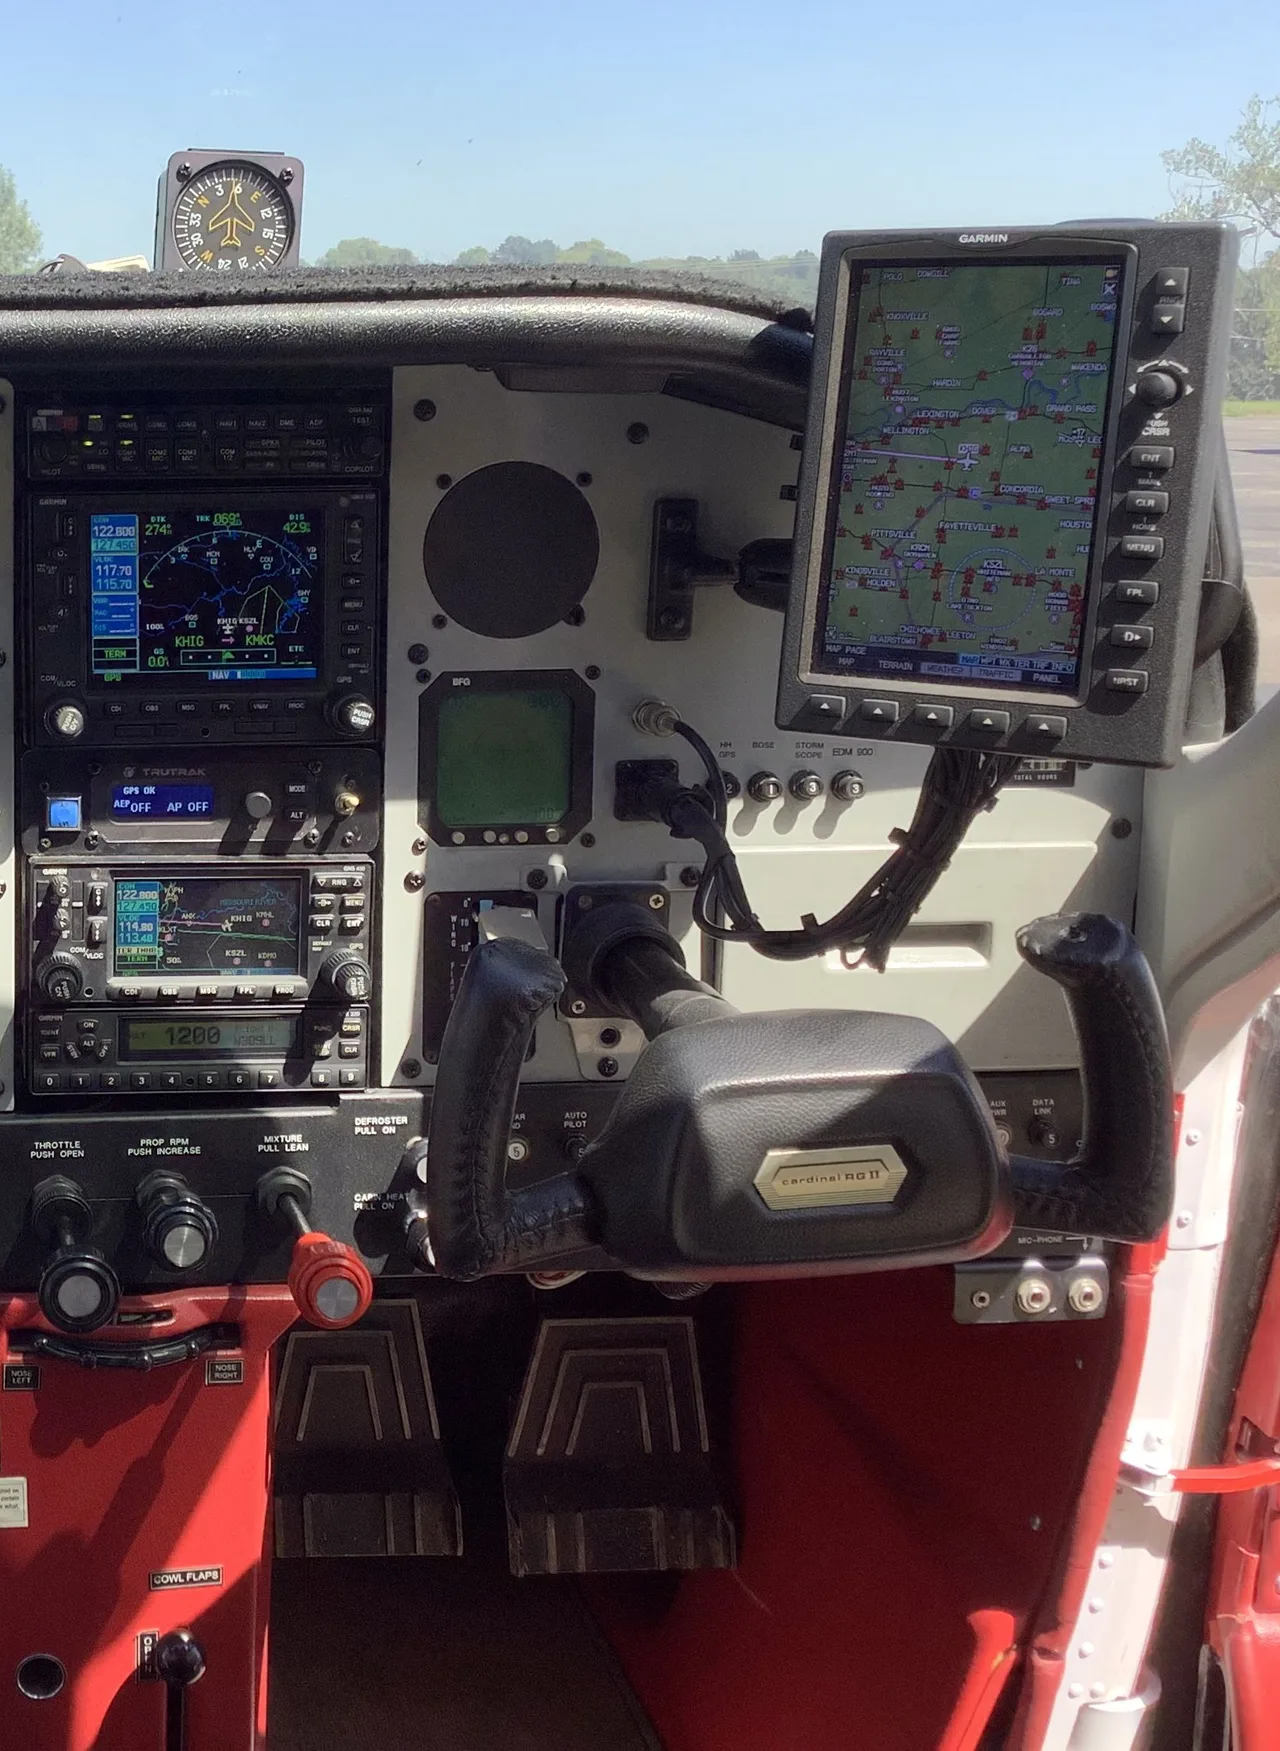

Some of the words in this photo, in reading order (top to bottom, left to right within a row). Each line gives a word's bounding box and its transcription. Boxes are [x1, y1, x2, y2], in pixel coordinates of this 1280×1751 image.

[198, 195, 210, 207] N
[250, 191, 261, 203] E
[260, 208, 272, 219] 12
[190, 213, 202, 227] 33
[958, 232, 1009, 244] GARMIN
[201, 250, 214, 263] W
[1141, 453, 1160, 462] ENT
[1000, 485, 1043, 493] CONCORDIA
[939, 522, 996, 531] FAYETTEVILLE
[96, 565, 132, 576] 117.70
[96, 579, 132, 589] 115.70
[175, 636, 204, 647] KHIG
[246, 635, 274, 646] KMKC
[879, 661, 913, 670] TERRAIN
[452, 678, 470, 686] BFG
[833, 748, 851, 756] EDM
[143, 768, 206, 777] TRUTRAK
[123, 787, 139, 795] GPS
[143, 786, 156, 795] OK
[130, 803, 152, 813] OFF
[168, 802, 183, 812] AP
[188, 802, 209, 812] OFF
[117, 890, 157, 899] 122.800
[117, 902, 157, 910] 127.450
[231, 915, 252, 923] KHIG
[119, 923, 153, 931] 114.80
[167, 1027, 220, 1045] 1200
[345, 1046, 357, 1054] CLR
[355, 1117, 408, 1126] DEFROSTER
[355, 1127, 378, 1135] PULL
[141, 1139, 166, 1147] PROP
[170, 1138, 189, 1146] RPM
[264, 1135, 302, 1143] MIXTURE
[34, 1141, 80, 1149] THROTTLE
[285, 1143, 309, 1151] LEAN
[60, 1150, 84, 1158] OPEN
[128, 1148, 152, 1156] PUSH
[157, 1147, 201, 1155] INCREASE
[782, 1173, 842, 1186] cardinal
[845, 1171, 866, 1181] RG
[154, 1573, 185, 1585] COWL
[187, 1570, 219, 1582] FLAPS
